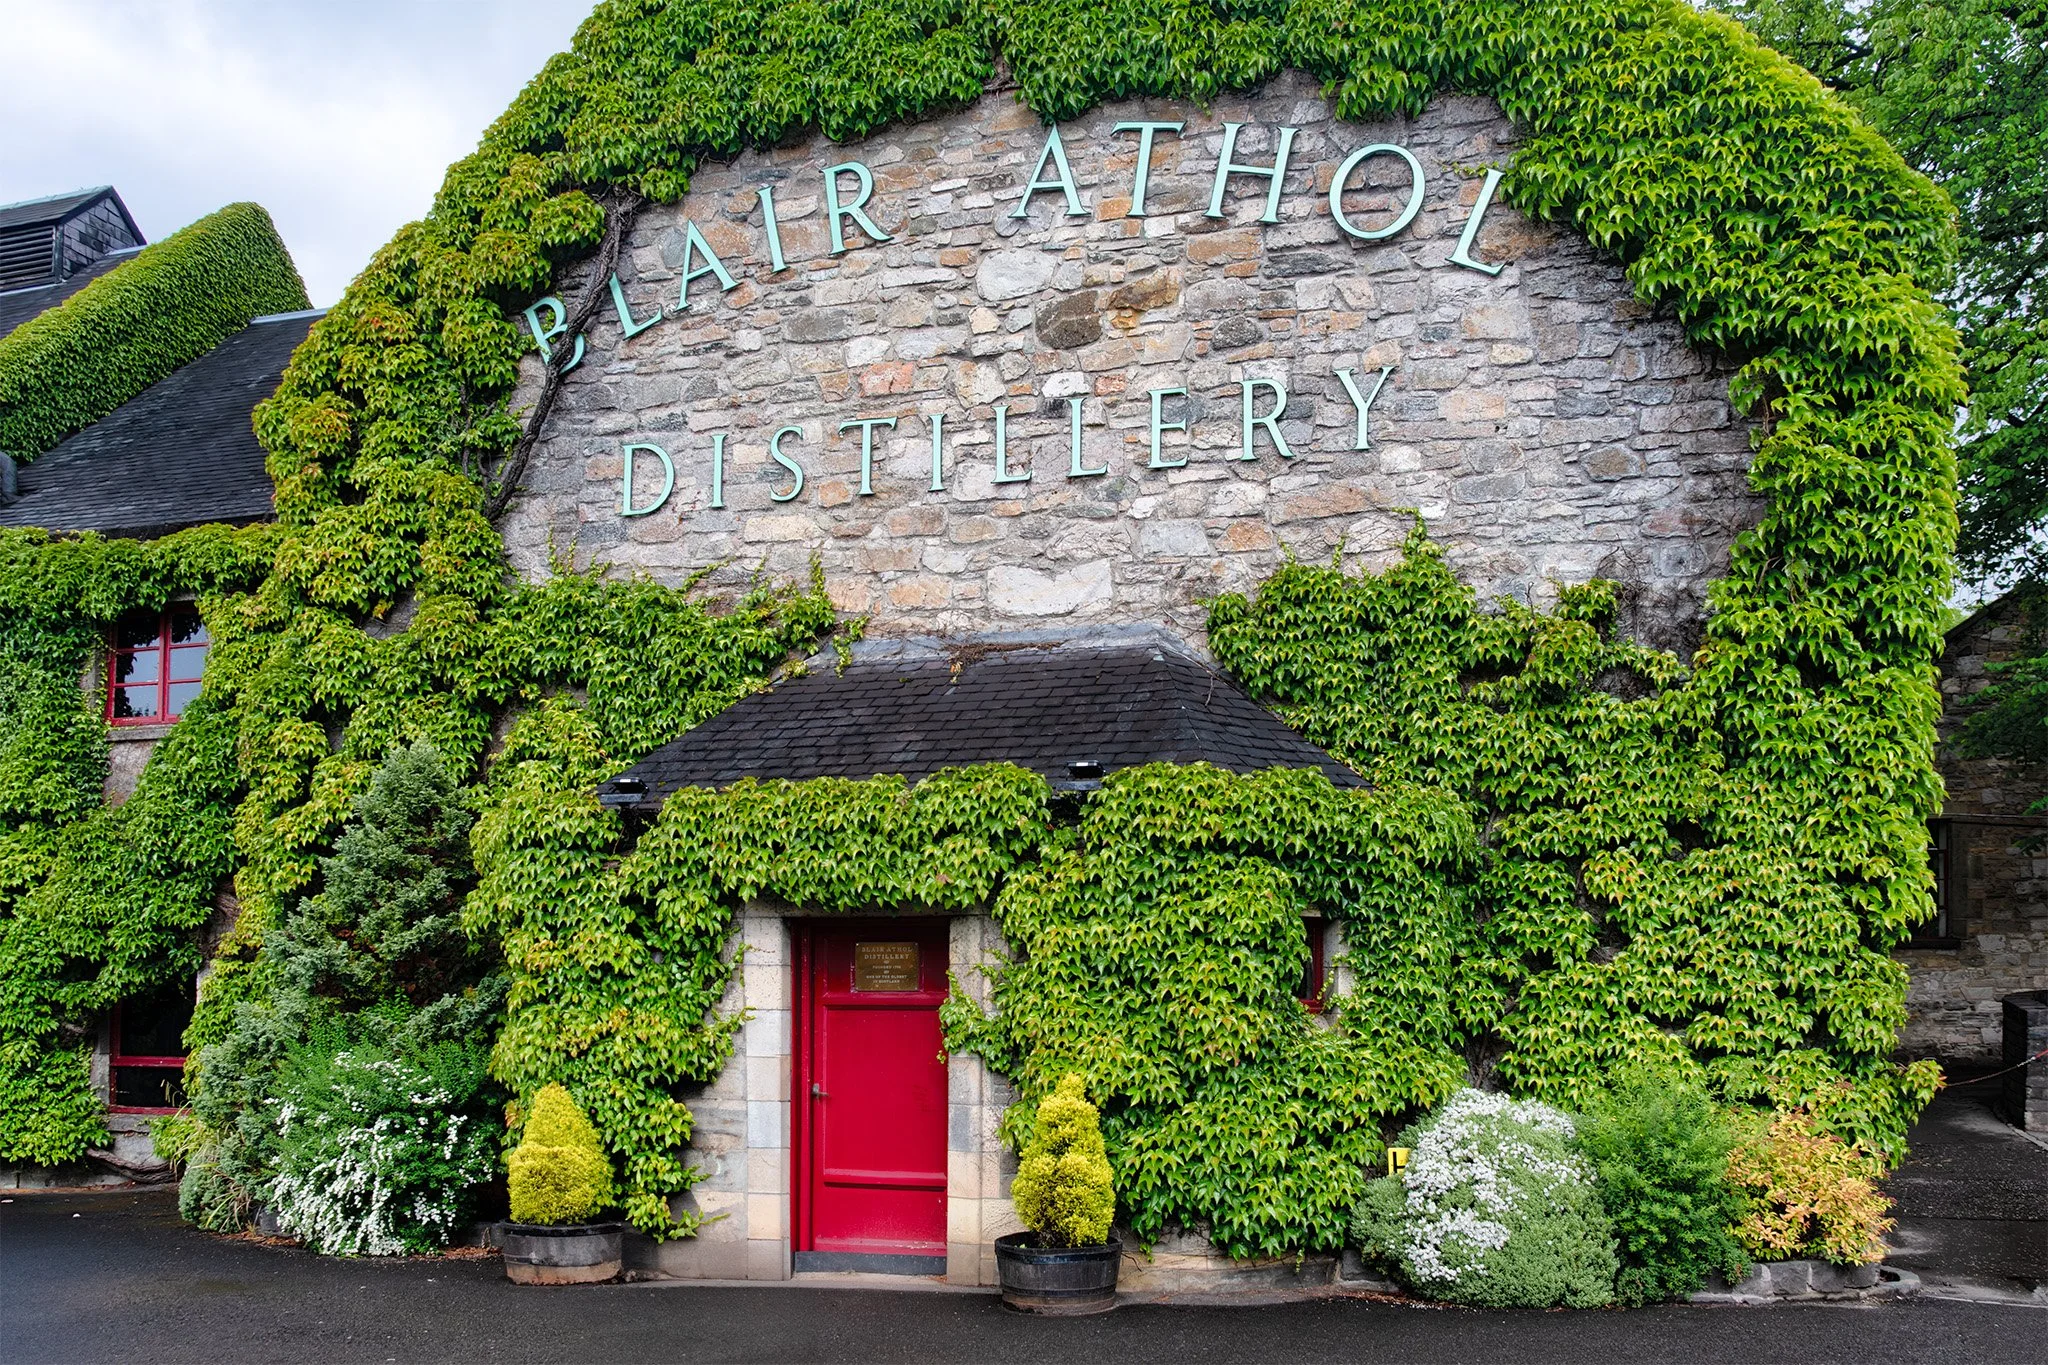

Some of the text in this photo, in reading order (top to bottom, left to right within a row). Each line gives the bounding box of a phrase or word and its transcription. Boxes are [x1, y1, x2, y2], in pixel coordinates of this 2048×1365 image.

[523, 119, 1525, 373] BLAIR ATHOL
[618, 366, 1397, 517] DISTILLERY
